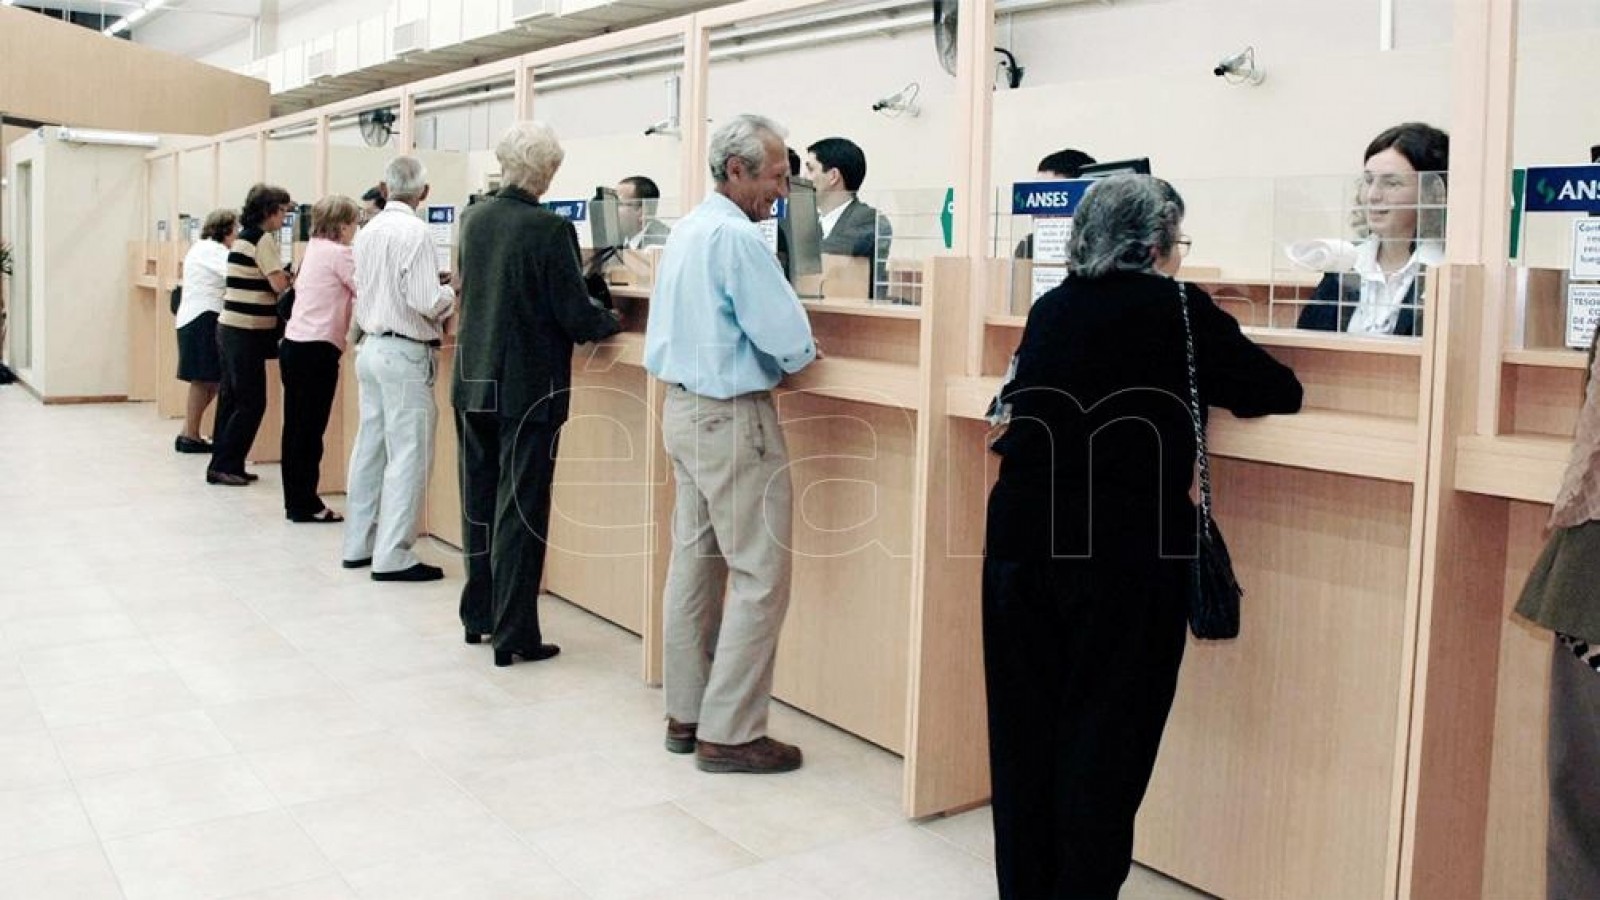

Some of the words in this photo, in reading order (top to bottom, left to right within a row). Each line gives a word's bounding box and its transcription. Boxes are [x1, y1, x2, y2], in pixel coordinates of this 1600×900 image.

[1557, 179, 1600, 200] AN
[1025, 192, 1069, 208] ANSES
[576, 202, 584, 218] 7
